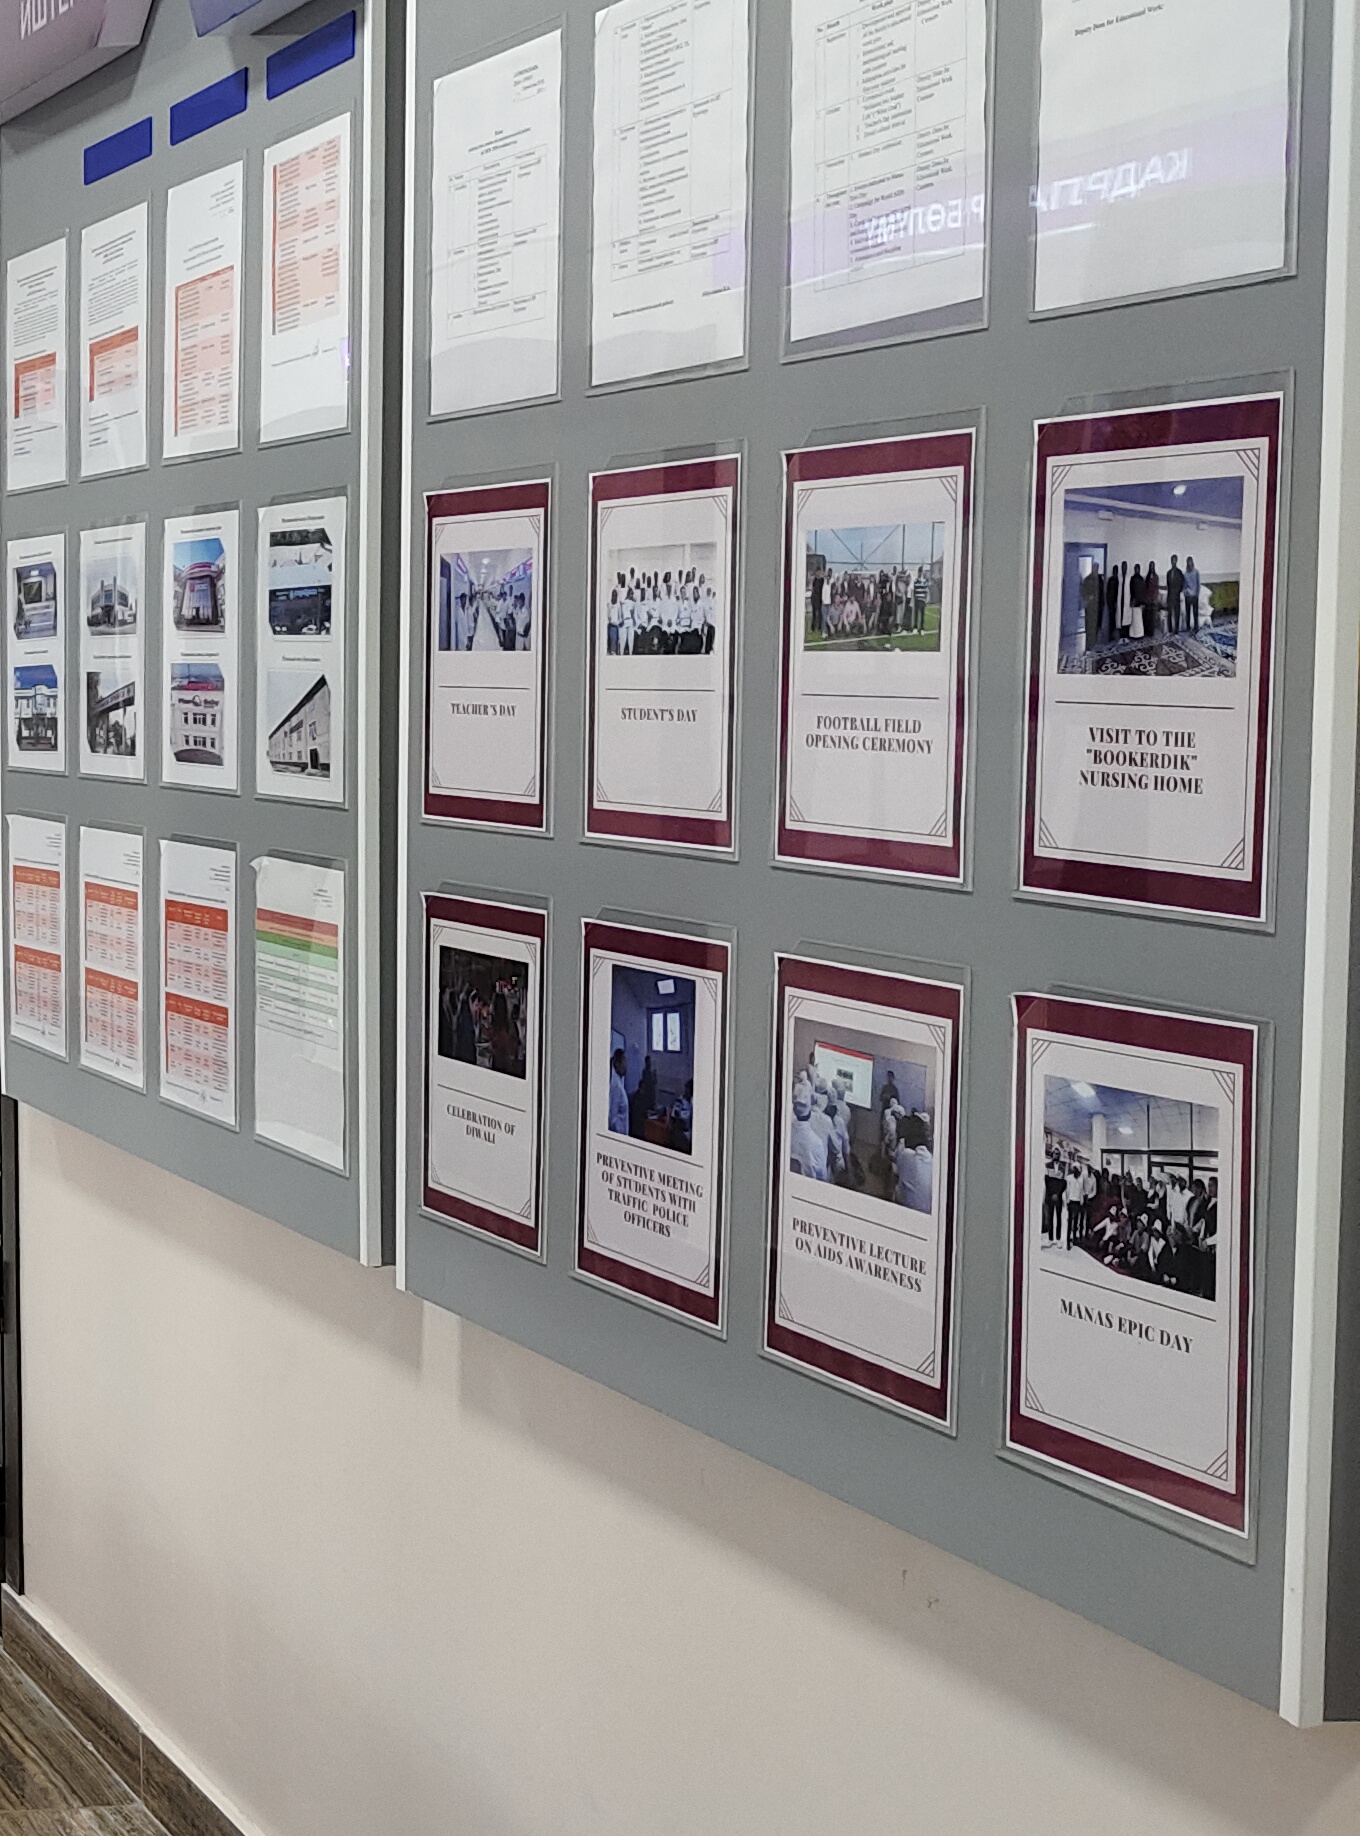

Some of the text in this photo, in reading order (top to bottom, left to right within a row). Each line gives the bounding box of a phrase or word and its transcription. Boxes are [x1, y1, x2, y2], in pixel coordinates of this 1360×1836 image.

[450, 703, 517, 717] TEACHER'S DAY
[621, 707, 698, 723] STUDENT'S DAY
[816, 715, 922, 735] FOOTBALL FIELD
[1088, 727, 1196, 749] VISIT TO THE
[805, 734, 934, 755] OPENING CEREMONY
[1087, 748, 1198, 772] "BOOKERDIK"
[1079, 770, 1204, 795] NURSING HOME
[447, 1104, 516, 1137] CELEBRATION OF
[596, 1152, 704, 1198] PREVENTIVE MEETING
[601, 1171, 697, 1214] OF STUDENTS WITH
[607, 1188, 689, 1228] TRAFFIC POLICE
[623, 1210, 671, 1239] OFFICERS
[792, 1217, 927, 1276] PREVENTIVE LECTURE
[795, 1236, 923, 1293] ON AIDS AWARENESS
[1060, 1298, 1194, 1355] MANAS EPIC DAY
